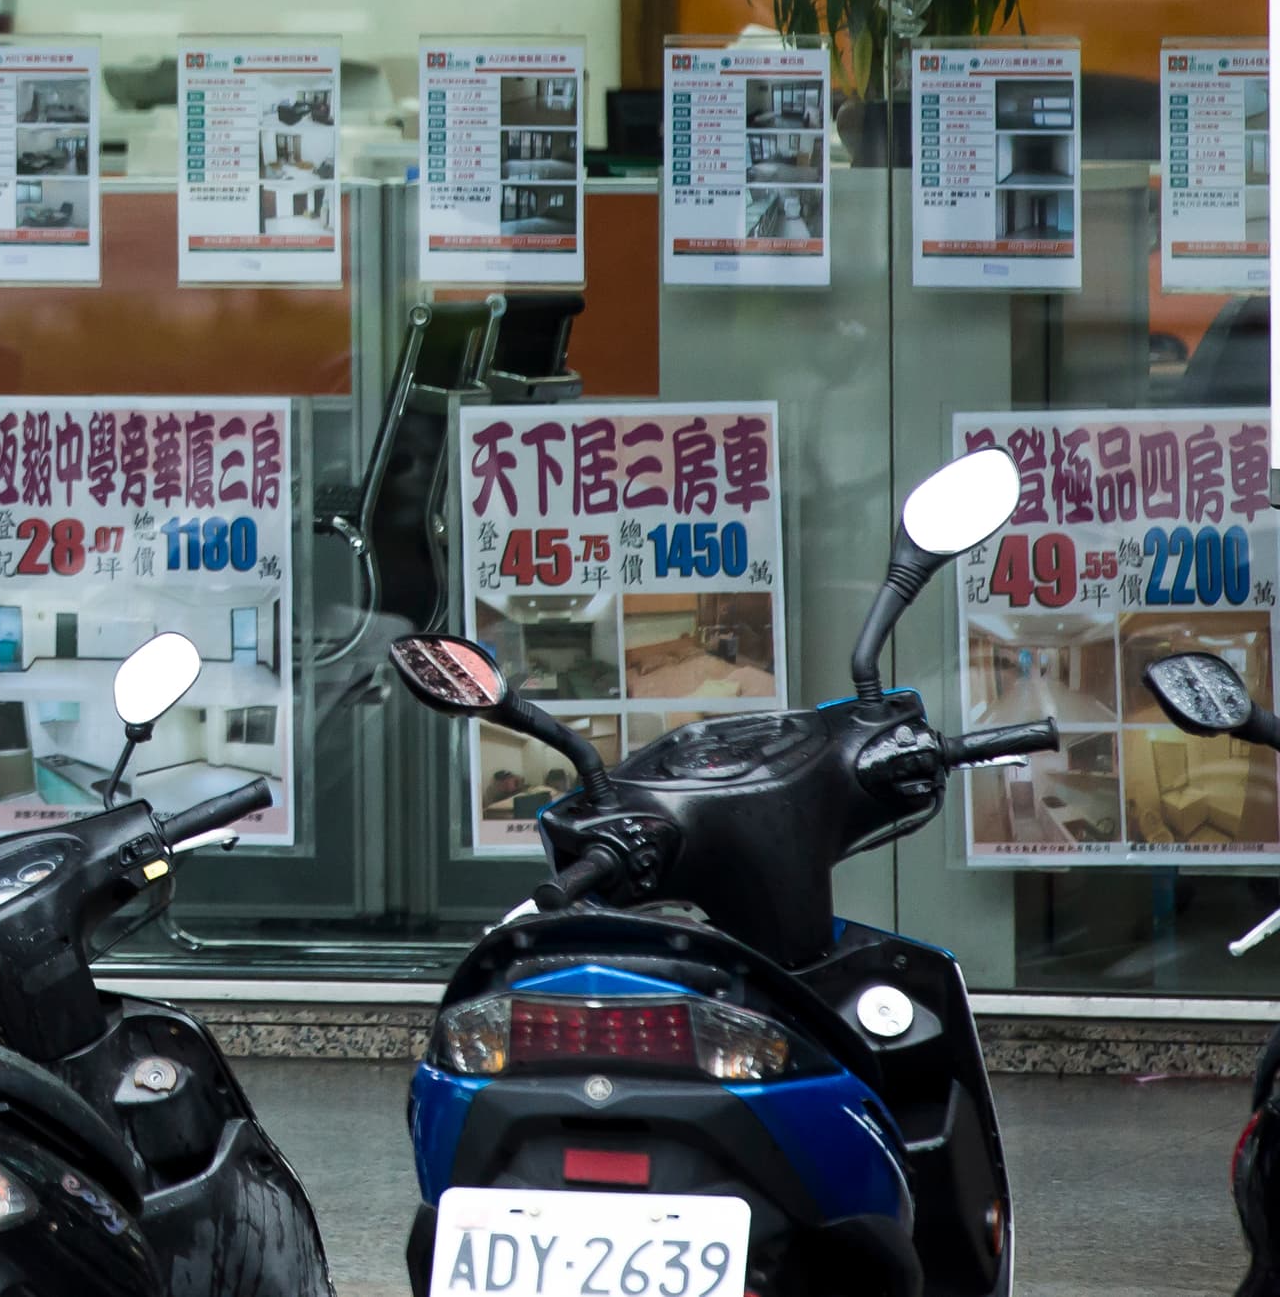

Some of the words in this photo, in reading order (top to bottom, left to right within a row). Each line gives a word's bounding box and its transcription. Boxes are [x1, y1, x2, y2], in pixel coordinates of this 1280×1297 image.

[471, 416, 771, 517] 天下居三房車
[964, 424, 1272, 526] 登極品四房車
[133, 512, 156, 578] 總價
[160, 515, 258, 573] 1180
[477, 520, 501, 590] 登記
[619, 518, 644, 586] 總價
[647, 520, 749, 579] 1450
[1118, 536, 1144, 607] 總價
[1143, 524, 1251, 607] 2200
